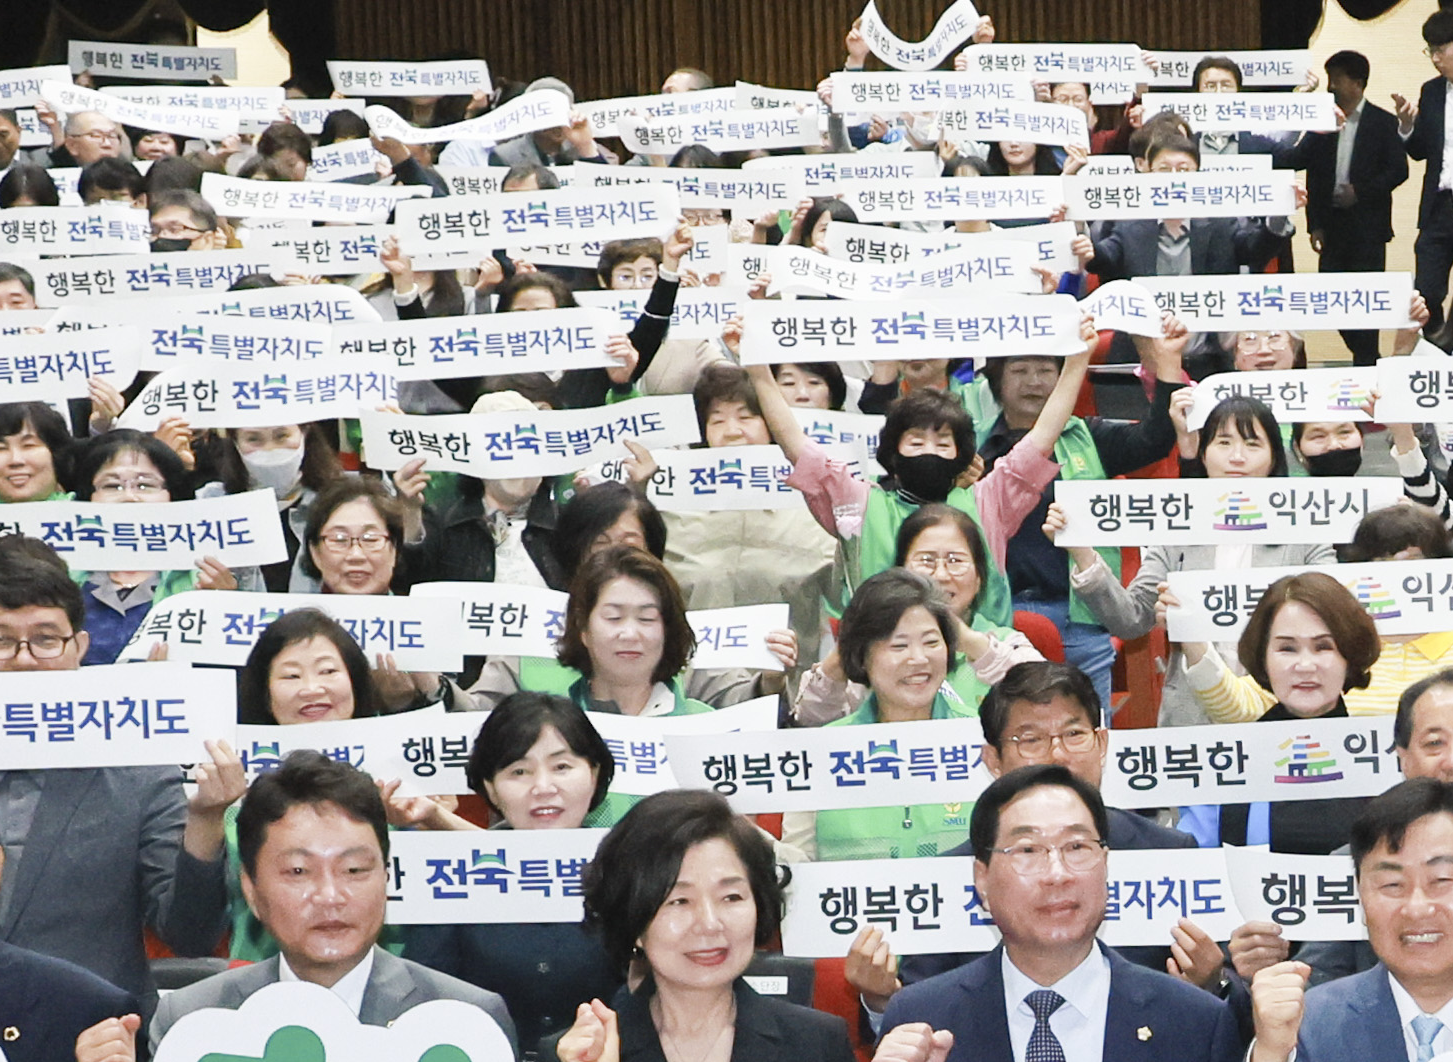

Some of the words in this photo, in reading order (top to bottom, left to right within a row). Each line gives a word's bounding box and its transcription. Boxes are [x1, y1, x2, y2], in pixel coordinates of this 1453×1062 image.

[82, 51, 122, 69] 행복한
[131, 51, 222, 71] 전북특별자치도
[979, 55, 1025, 71] 행복한
[1034, 52, 1135, 72] 전북특별자치도
[339, 69, 383, 88] 행복한
[390, 69, 480, 86] 전북특별자치도
[851, 83, 900, 102] 행복한
[909, 79, 1016, 103] 전북특별자치도
[976, 107, 1081, 136] 전북특별자치도
[1160, 104, 1207, 121] 행복한
[1216, 101, 1316, 121] 전북특별자치도
[635, 127, 682, 146] 행복한
[692, 119, 800, 142] 전북특별자치도
[223, 188, 279, 208] 행복한
[662, 177, 787, 199] 전북특별자치도
[859, 190, 914, 211] 행복한
[925, 186, 1043, 209] 전북특별자치도
[1085, 186, 1141, 209] 행복한
[1151, 182, 1273, 206] 전북특별자치도
[1, 220, 56, 243] 행복한
[419, 210, 490, 240] 행복한
[503, 201, 657, 233] 전북특별자치도
[47, 270, 115, 297] 행복한
[1154, 291, 1225, 321] 행복한
[1238, 286, 1391, 315] 전북특별자치도
[772, 317, 856, 347] 행복한
[872, 312, 1055, 343] 전북특별자치도
[430, 327, 595, 362] 전북특별자치도
[142, 380, 218, 415] 행복한
[388, 430, 470, 463] 행복한
[485, 412, 665, 463] 전북특별자치도
[1090, 494, 1193, 531] 행복한
[1269, 489, 1370, 525] 익산시
[40, 515, 254, 552] 전북특별자치도
[702, 751, 812, 795] 행복한
[1116, 741, 1248, 790] 행복한
[819, 883, 943, 934] 행복한
